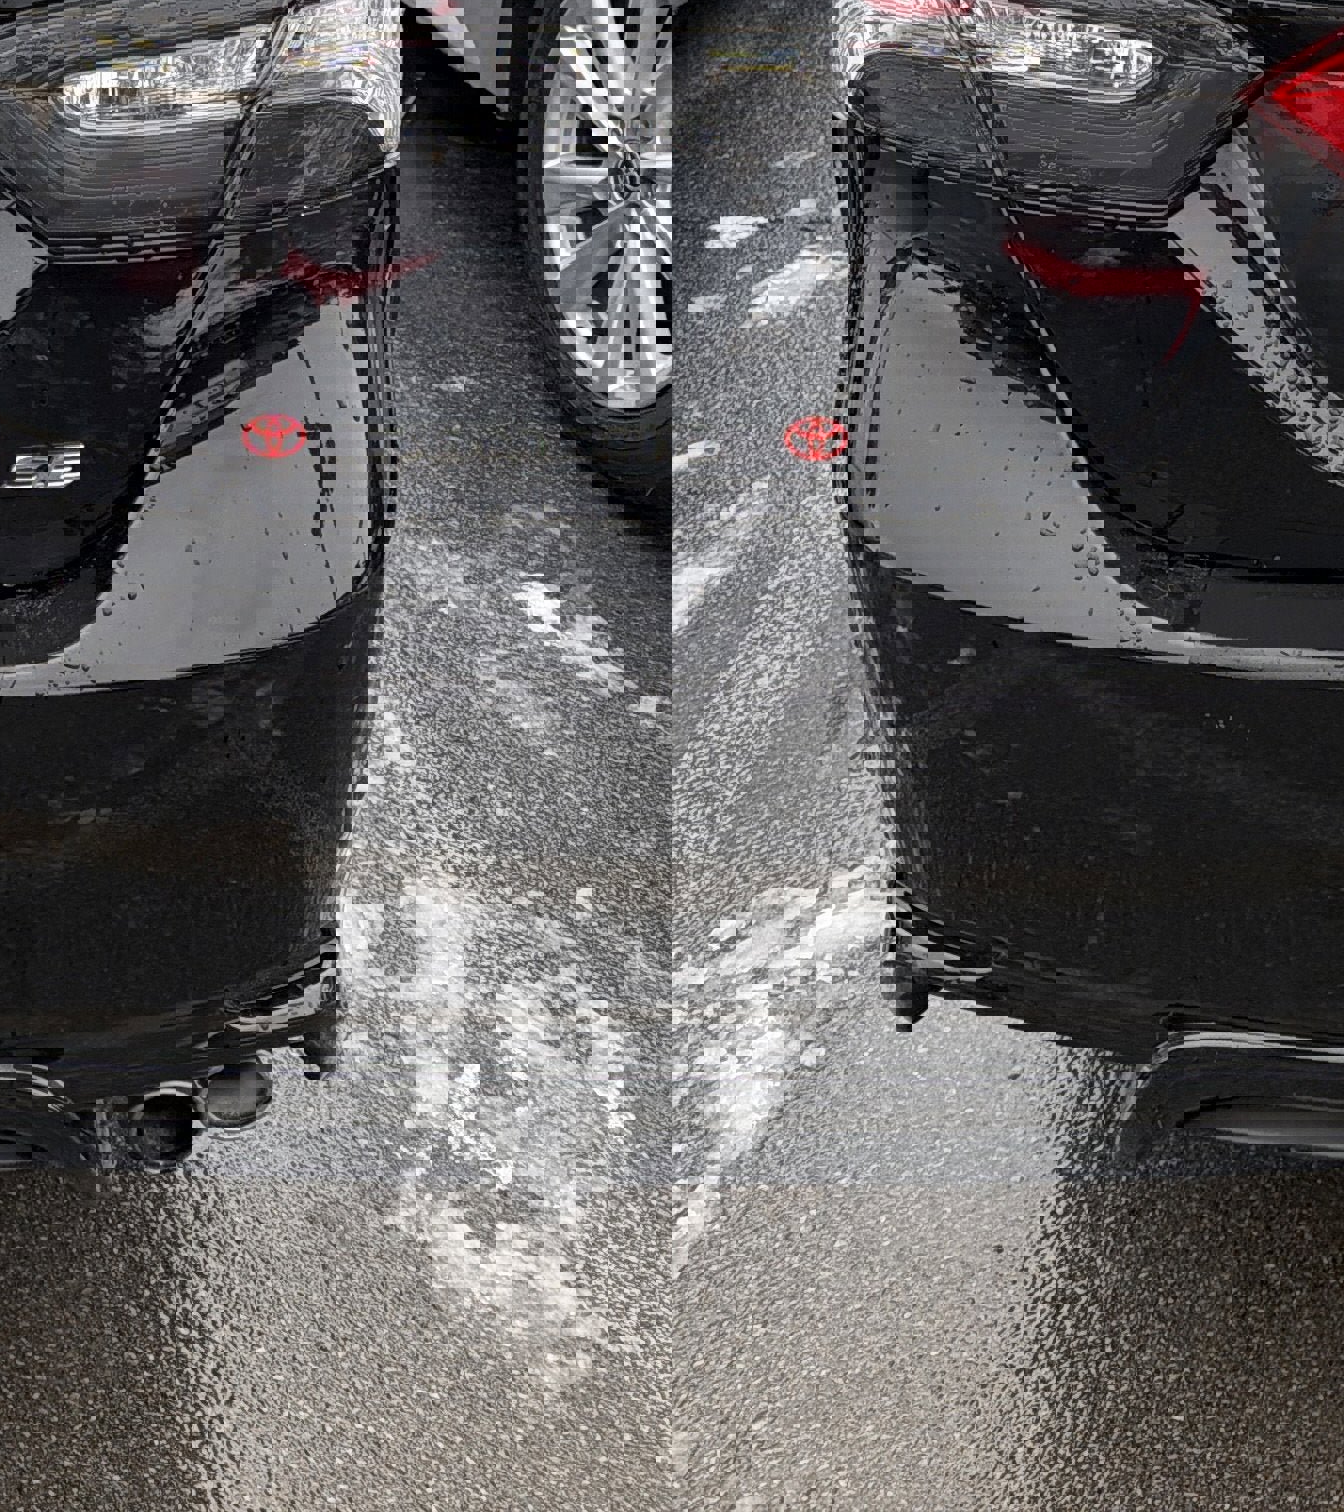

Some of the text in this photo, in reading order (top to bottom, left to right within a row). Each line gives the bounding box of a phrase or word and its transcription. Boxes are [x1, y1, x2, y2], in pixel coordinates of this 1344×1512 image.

[73, 29, 1038, 85] CAMRY
[368, 121, 723, 150] EAST SYRACUSE
[366, 429, 723, 460] ROMANO
